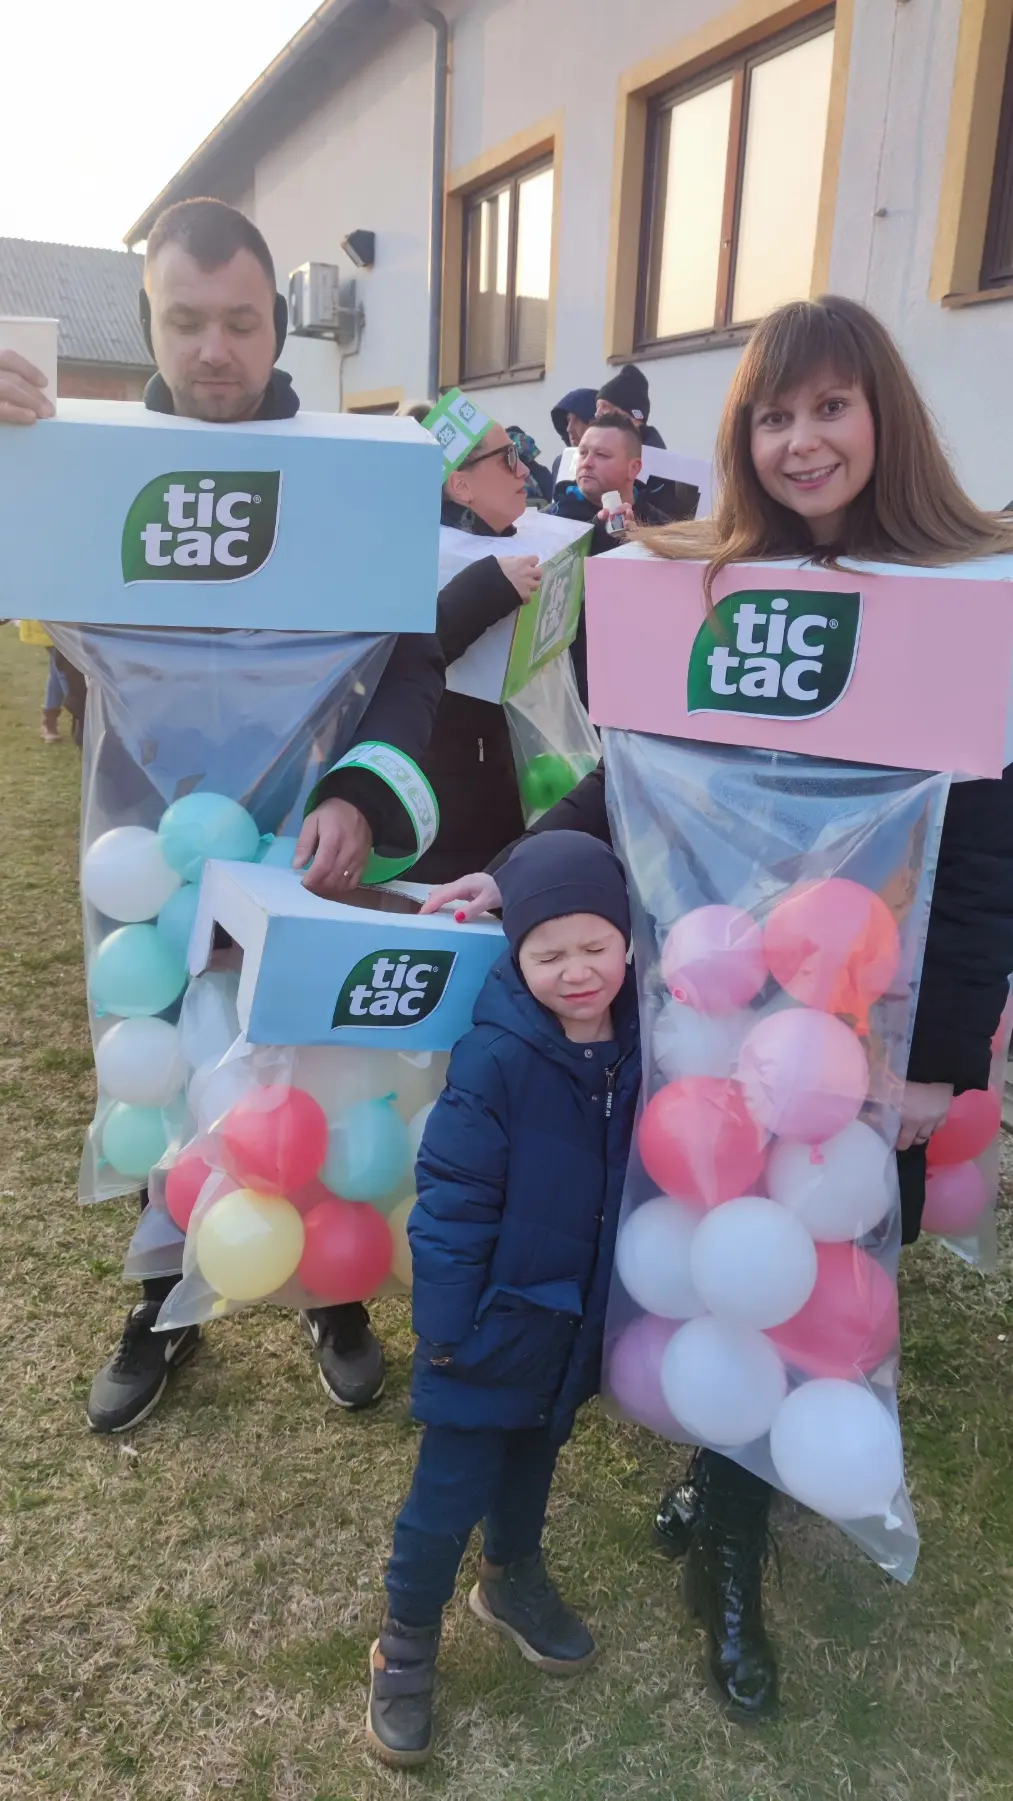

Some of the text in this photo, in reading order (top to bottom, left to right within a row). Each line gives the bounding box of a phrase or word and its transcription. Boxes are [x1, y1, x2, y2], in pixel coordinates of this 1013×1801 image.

[140, 523, 250, 566] tac
[707, 646, 823, 701] tac
[349, 984, 426, 1016] tac
